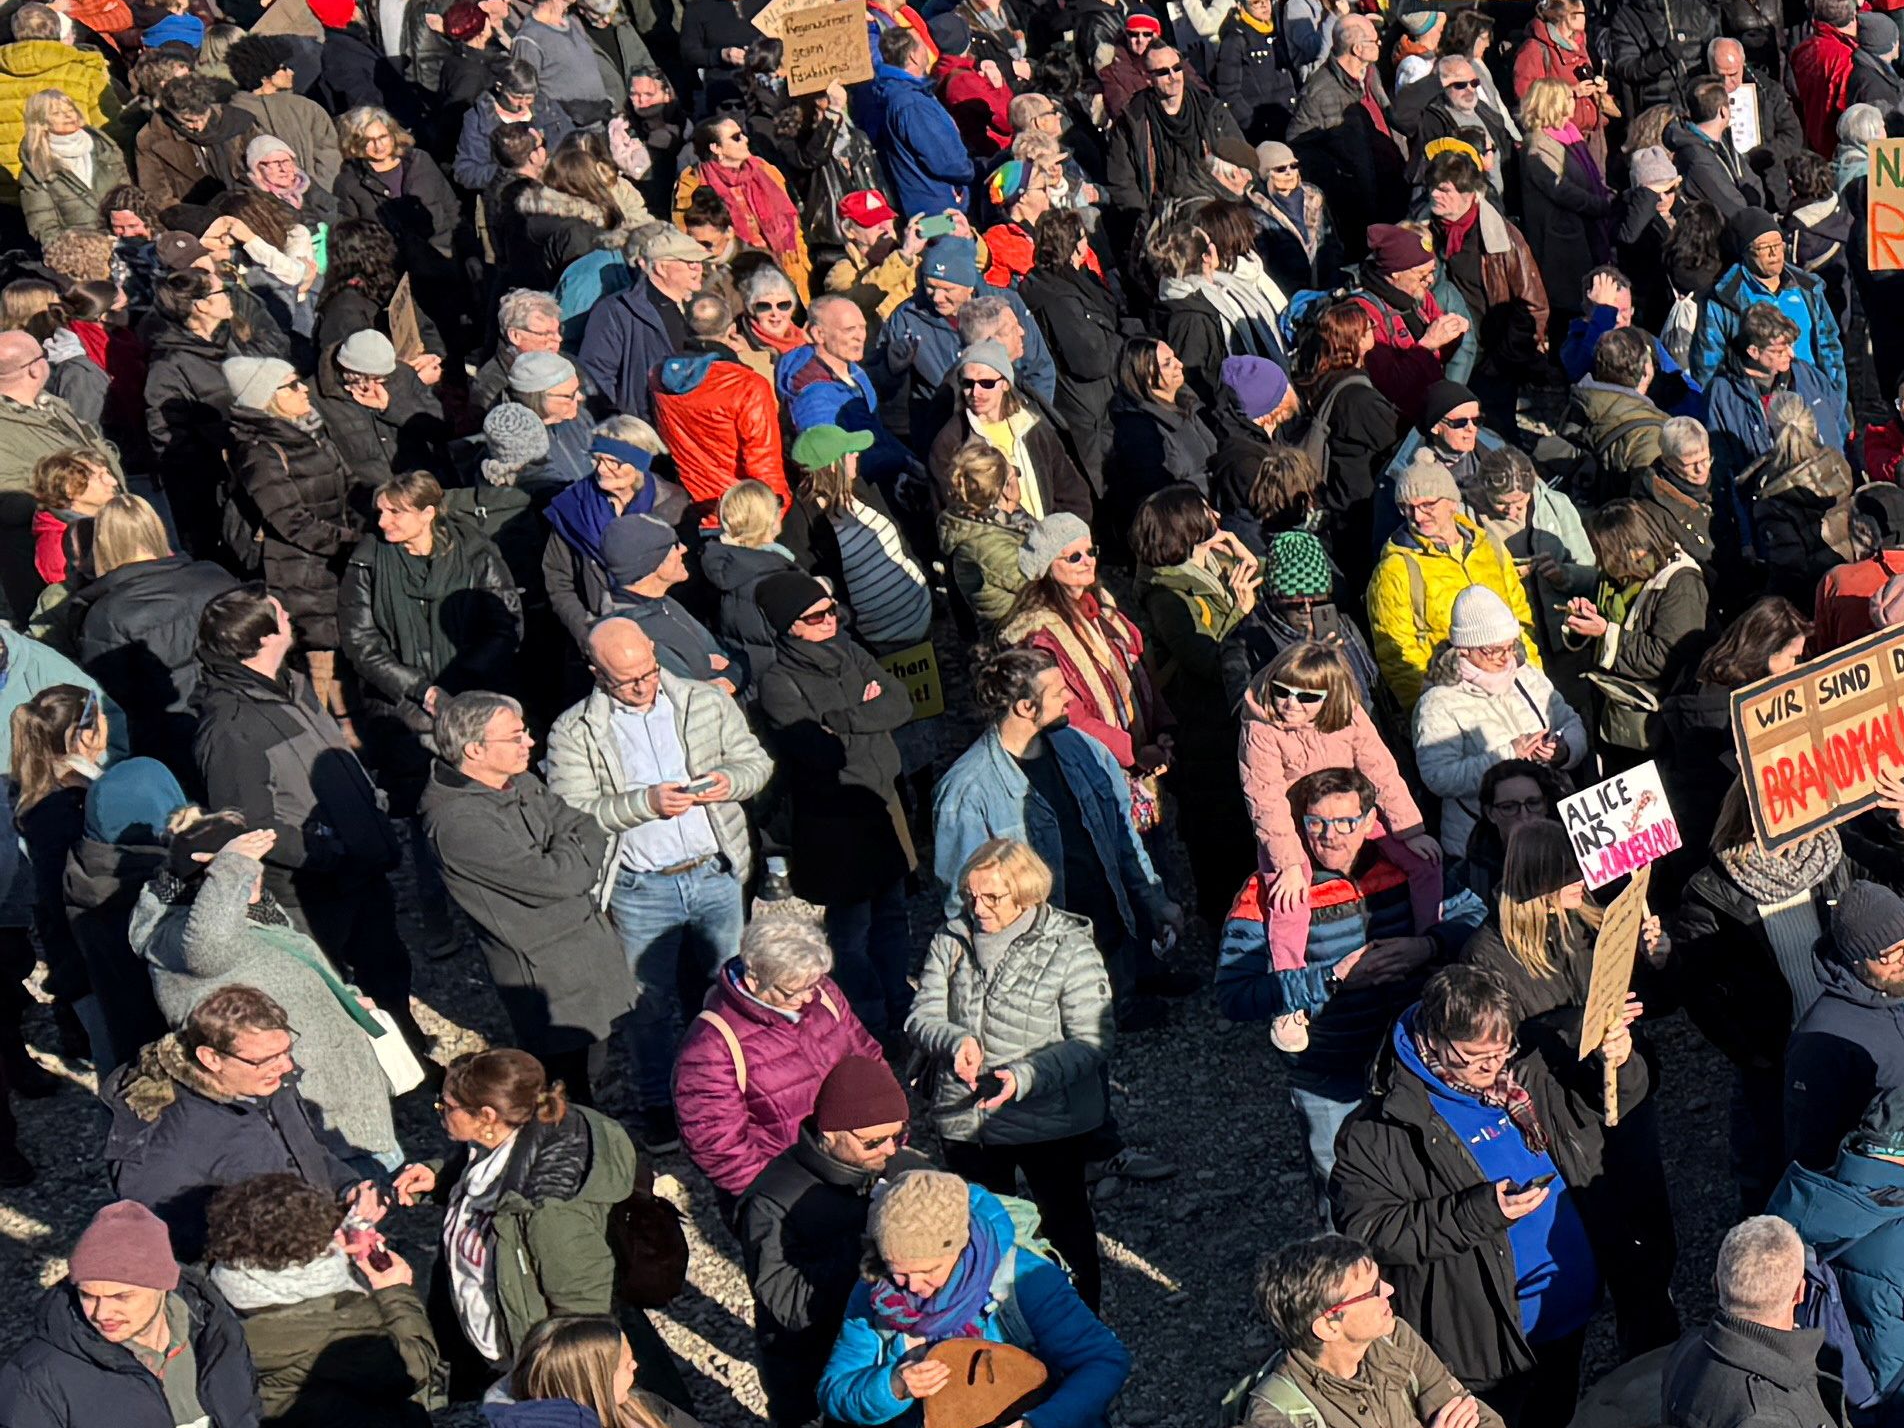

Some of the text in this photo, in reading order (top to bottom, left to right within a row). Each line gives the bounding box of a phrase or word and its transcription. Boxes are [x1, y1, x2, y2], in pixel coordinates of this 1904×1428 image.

[1754, 687, 1804, 731] WIR
[1817, 661, 1873, 707] SIND
[1566, 776, 1634, 831] ALICE
[1572, 818, 1617, 859] INS
